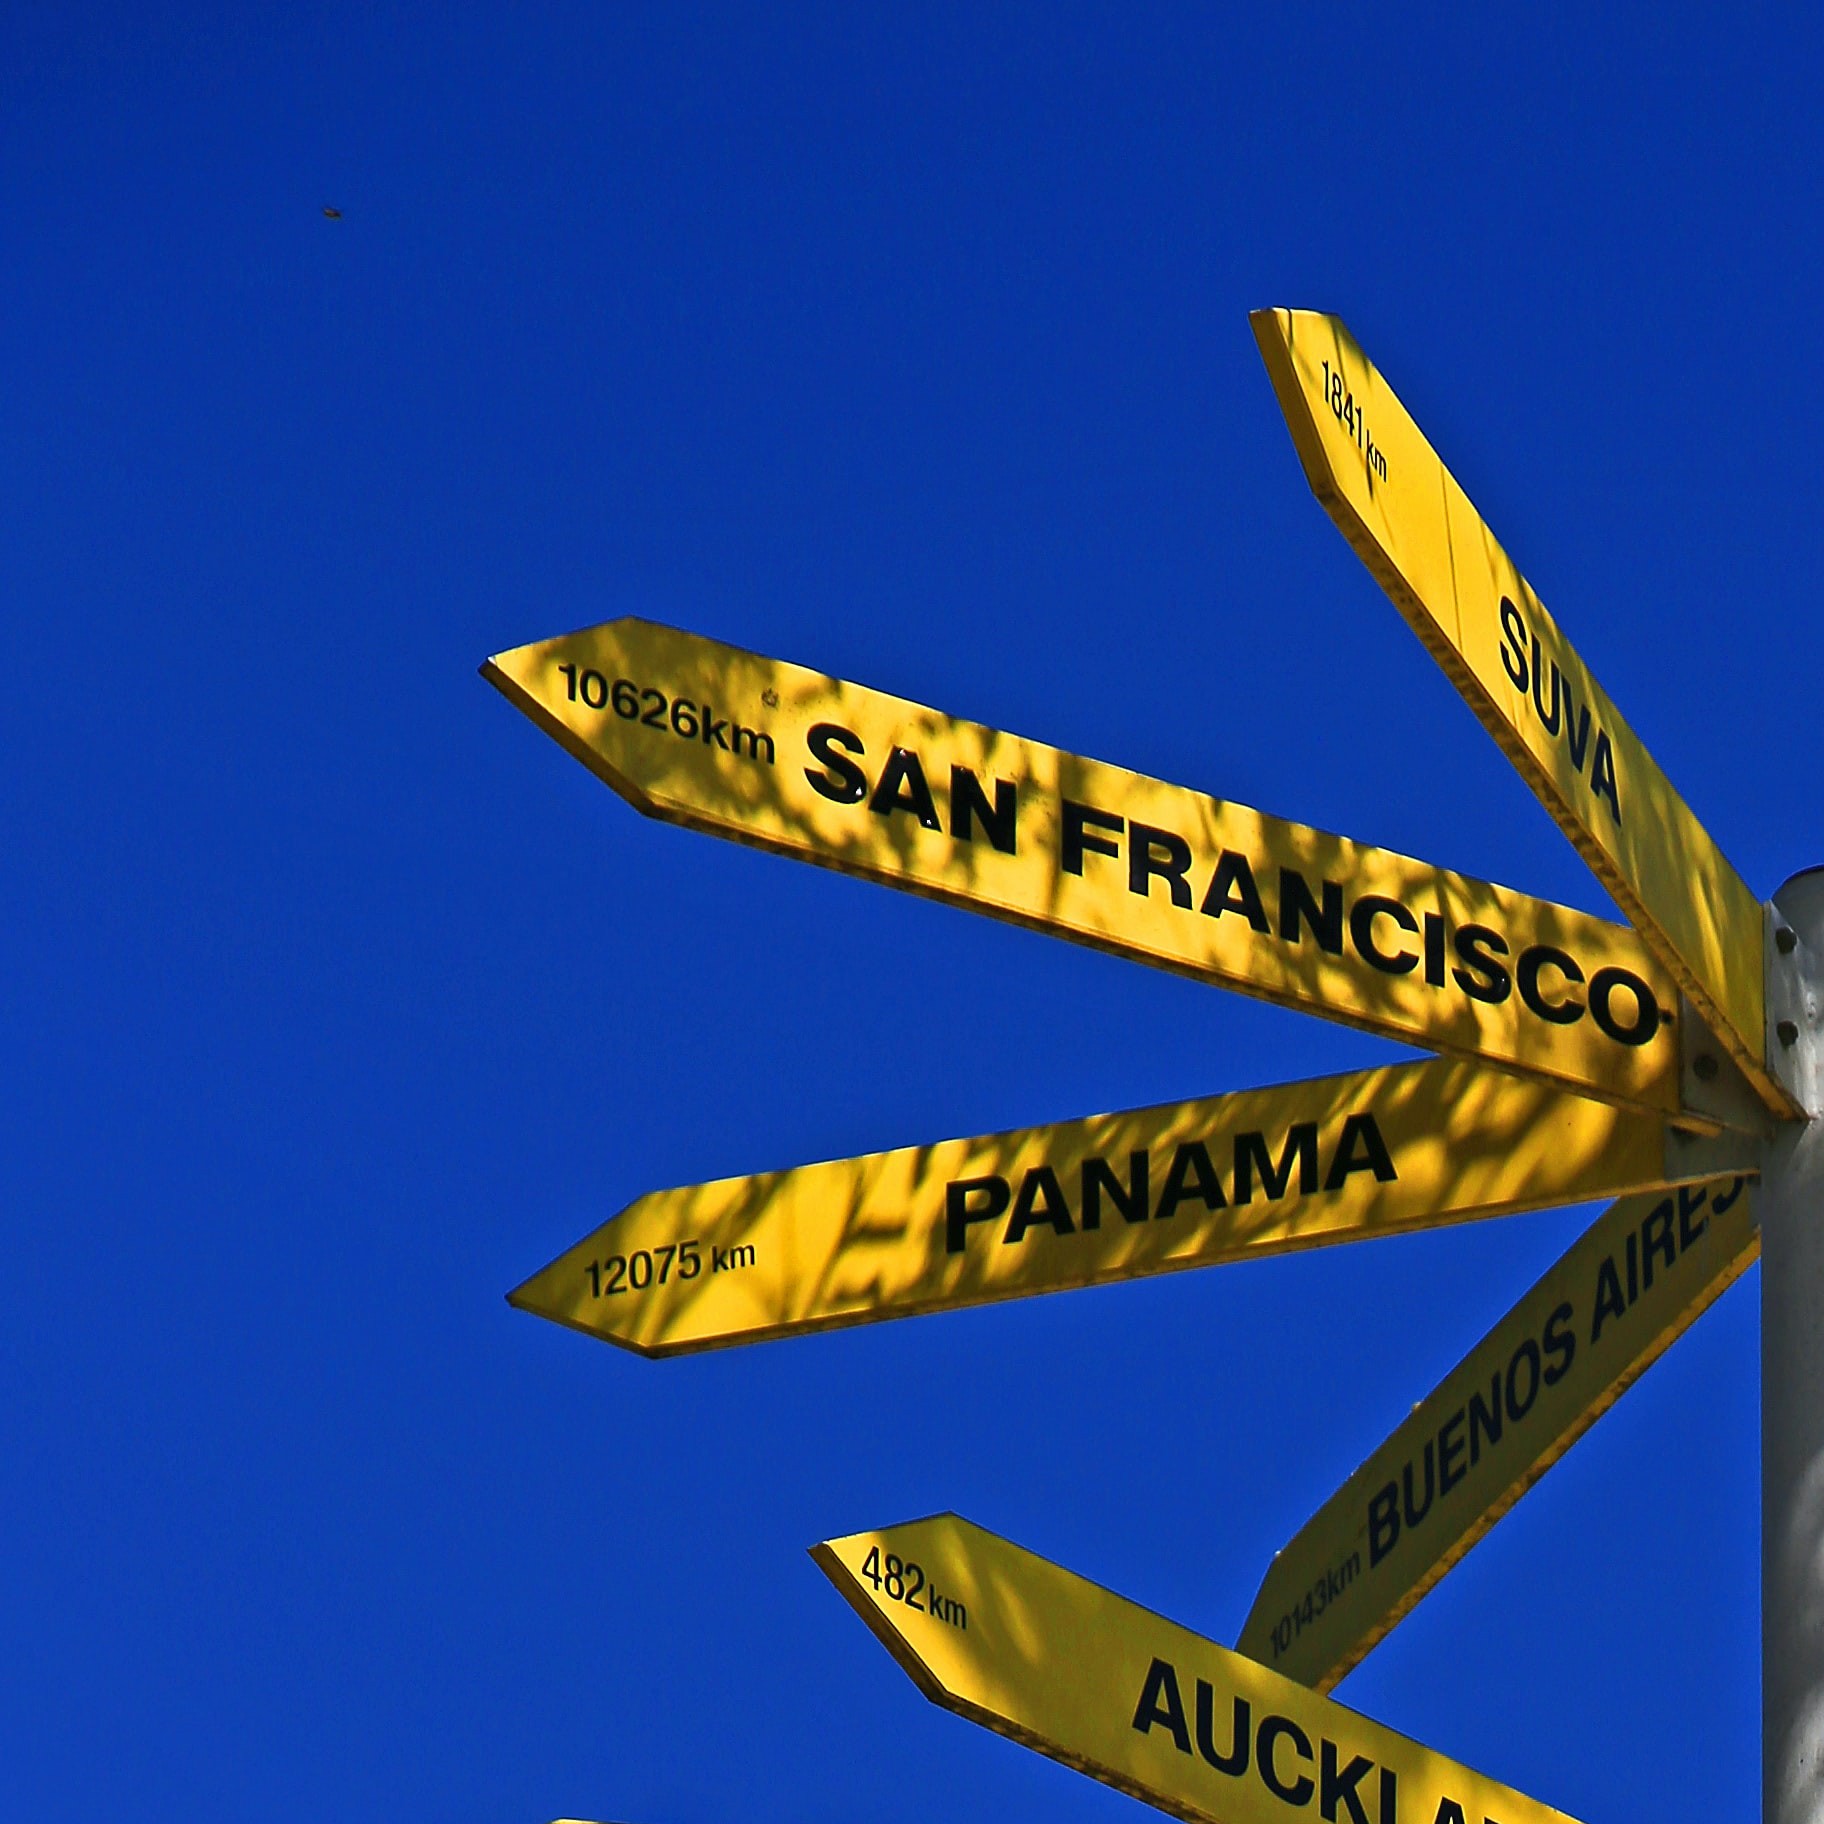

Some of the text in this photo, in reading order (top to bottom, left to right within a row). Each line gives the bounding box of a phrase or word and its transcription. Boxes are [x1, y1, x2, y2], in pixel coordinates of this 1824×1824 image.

[1322, 360, 1387, 483] 1841 km
[558, 663, 776, 765] 10626km
[1500, 595, 1622, 827] SUVA
[802, 721, 1661, 1048] SAN FRANCISCO
[945, 1112, 1398, 1255] PANAMA
[584, 1239, 756, 1299] 12075 km
[1367, 1301, 1576, 1570] BUENOS
[862, 1545, 967, 1630] 482 km
